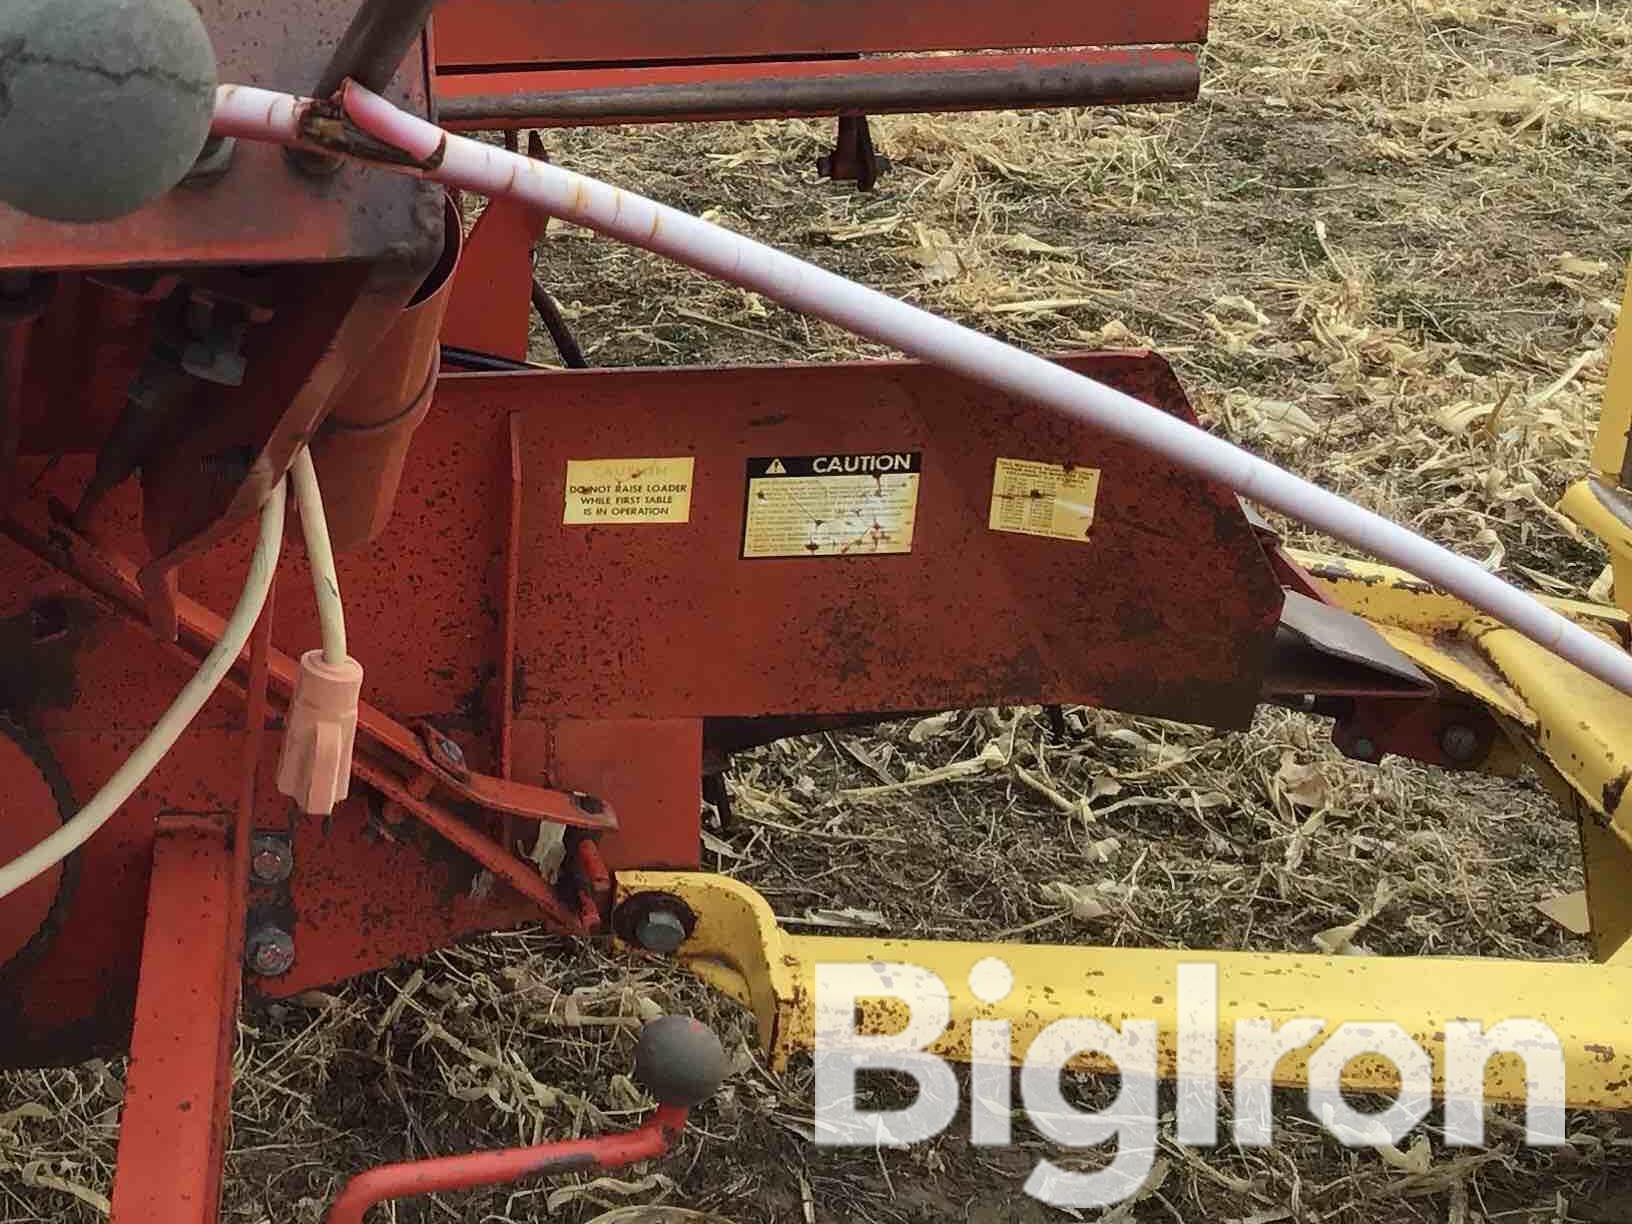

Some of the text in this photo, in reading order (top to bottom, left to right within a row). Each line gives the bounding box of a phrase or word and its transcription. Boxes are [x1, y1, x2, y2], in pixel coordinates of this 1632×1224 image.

[812, 453, 912, 473] CAUTION
[591, 485, 610, 493] NOT
[615, 484, 642, 494] RAISE
[647, 483, 687, 493] LOADER
[580, 495, 672, 505] WHILE FIRST TABLE
[583, 506, 669, 516] IS IN OPERATION
